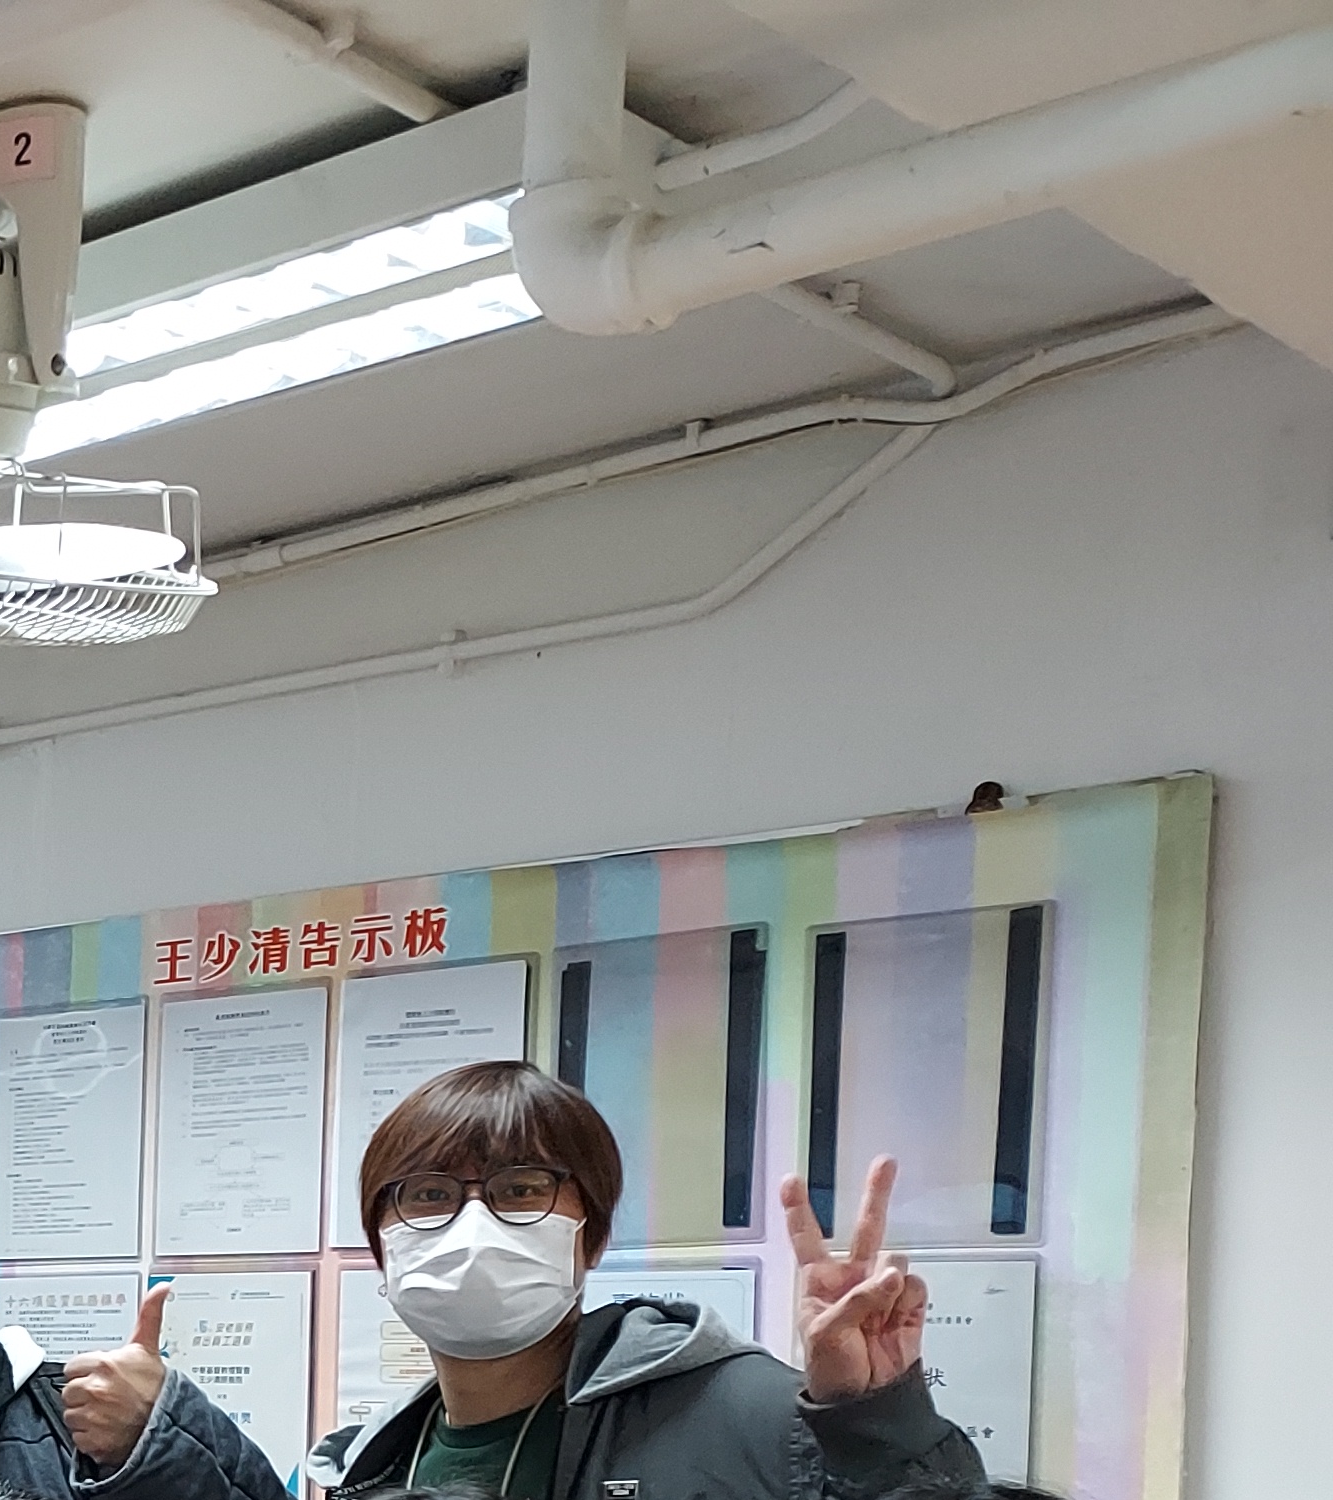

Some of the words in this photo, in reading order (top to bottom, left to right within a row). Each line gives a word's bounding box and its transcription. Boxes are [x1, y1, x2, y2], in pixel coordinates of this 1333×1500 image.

[14, 131, 32, 167] 2
[153, 907, 449, 985] 王少清告示板
